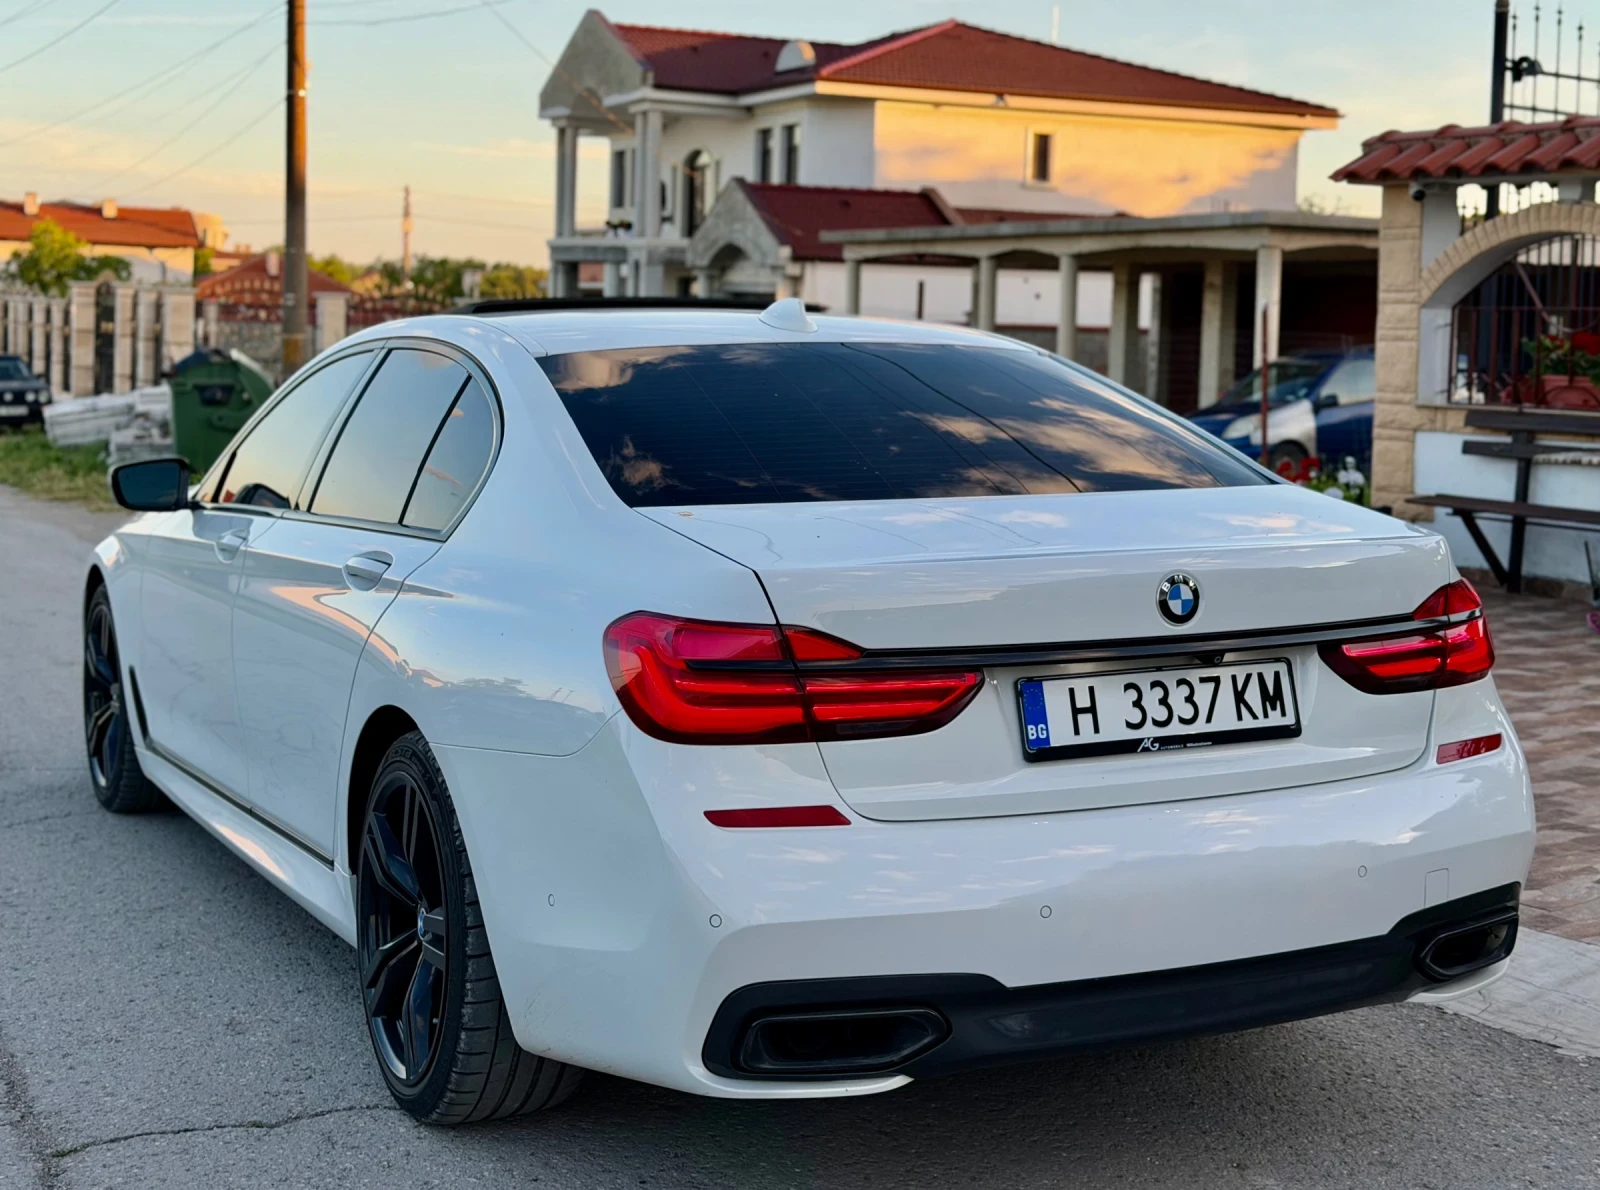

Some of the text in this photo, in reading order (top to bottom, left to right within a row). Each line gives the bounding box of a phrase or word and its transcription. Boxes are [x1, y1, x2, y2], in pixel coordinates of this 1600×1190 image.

[1161, 575, 1197, 592] BMW
[1068, 670, 1287, 736] H 3337 KM
[1027, 724, 1048, 740] BG
